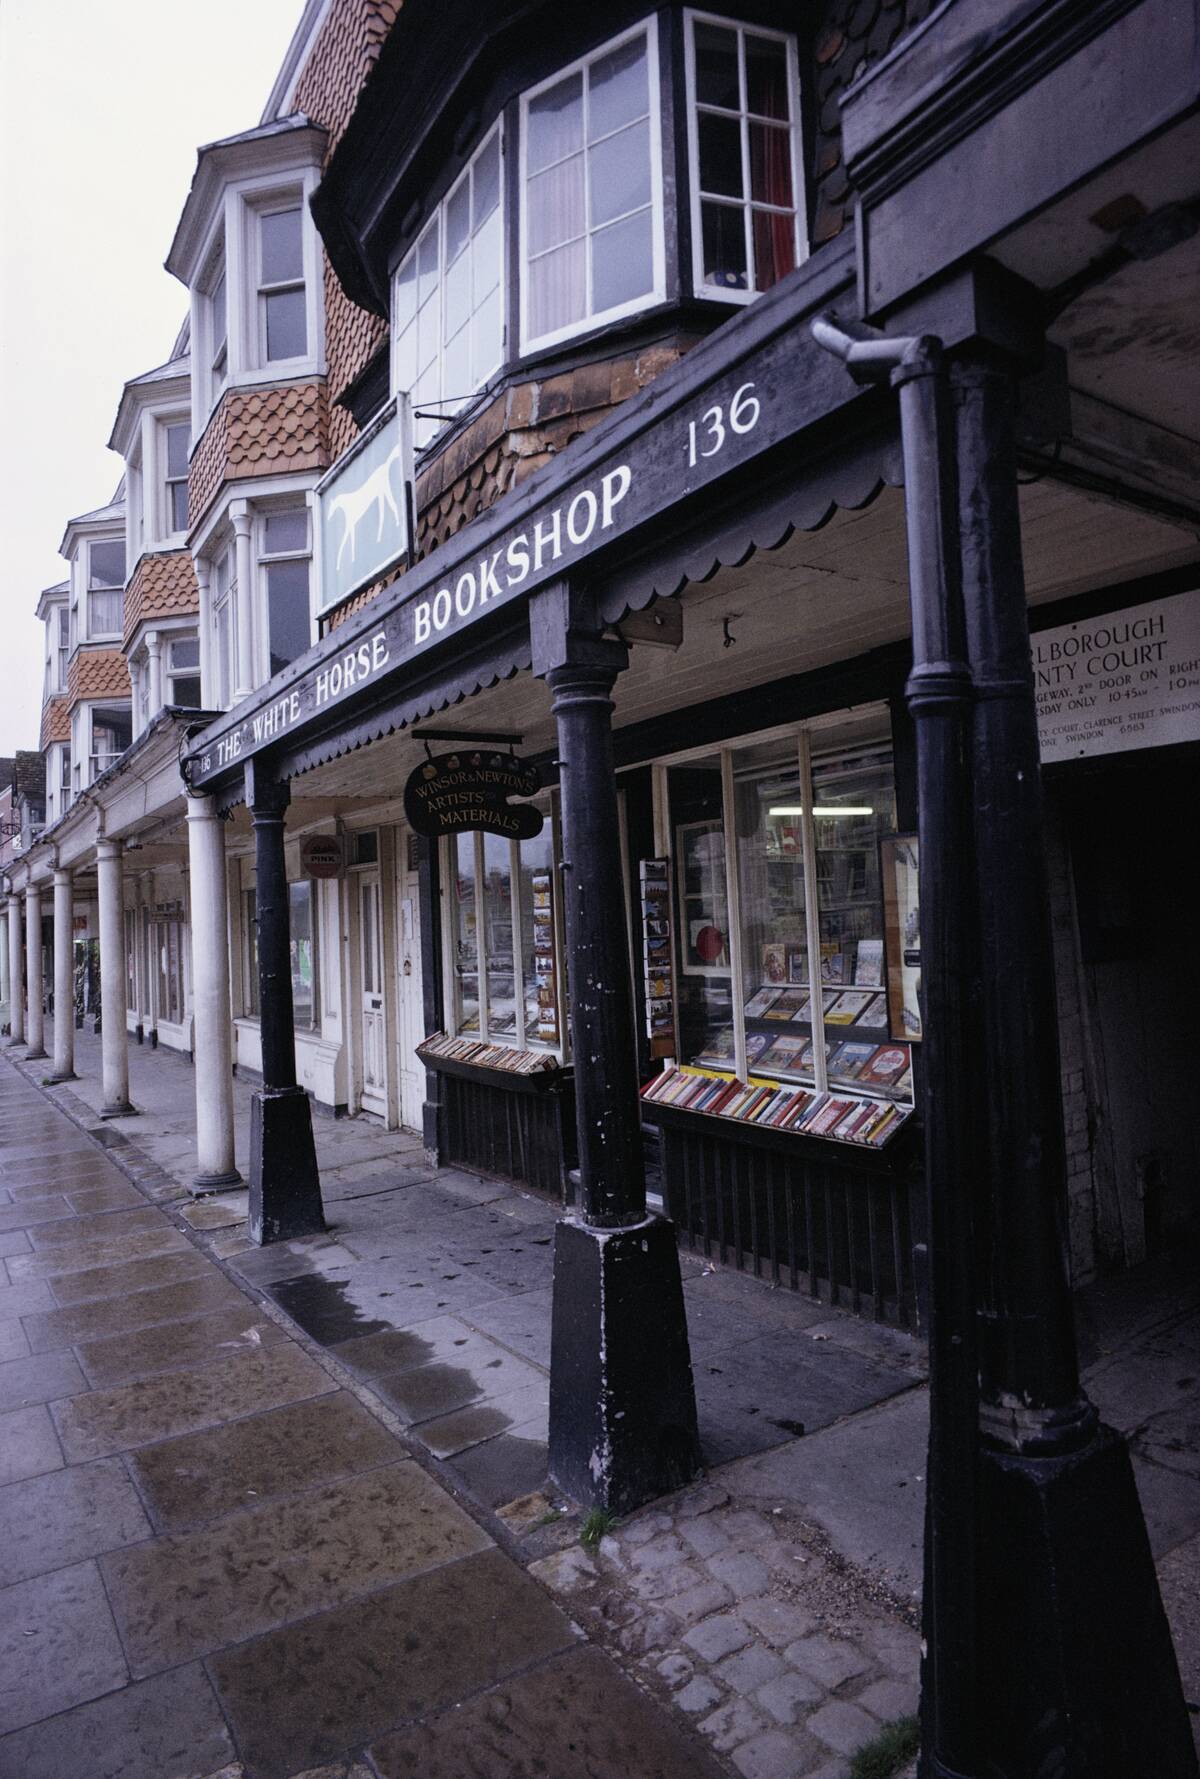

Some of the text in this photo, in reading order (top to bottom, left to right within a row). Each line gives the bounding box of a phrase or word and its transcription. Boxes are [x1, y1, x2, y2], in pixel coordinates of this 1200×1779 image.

[201, 382, 760, 773] 136 THE WHITE HORSE BOOKSHOP 136
[1033, 640, 1168, 687] NTY COURT
[1099, 674, 1132, 690] DOOR
[1140, 668, 1158, 681] ON
[1169, 658, 1200, 674] RIGH
[1068, 696, 1097, 710] ONLY
[415, 770, 469, 799] WINSOR
[439, 808, 521, 831] MATERIALS
